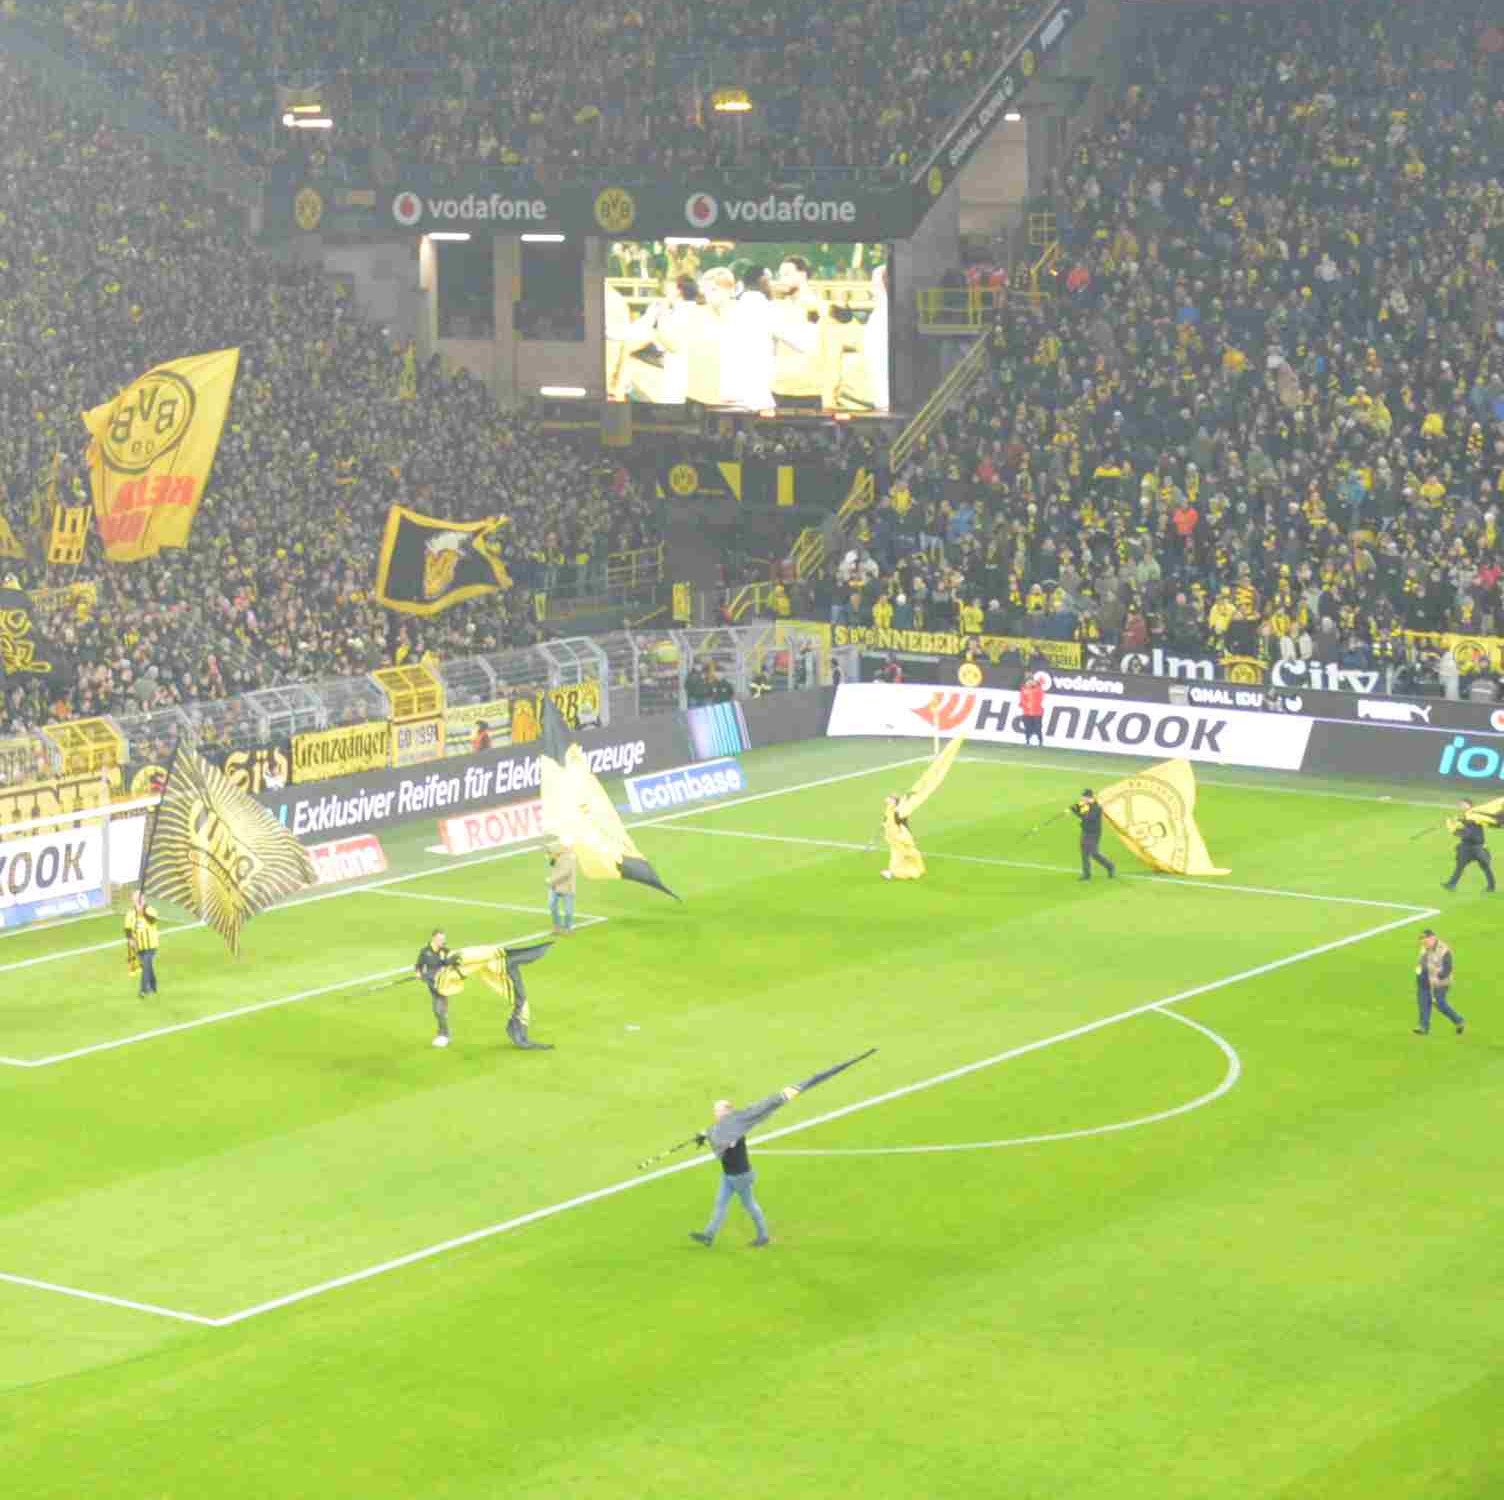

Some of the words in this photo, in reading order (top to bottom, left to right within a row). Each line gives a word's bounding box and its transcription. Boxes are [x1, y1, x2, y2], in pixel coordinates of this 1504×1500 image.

[428, 195, 547, 221] vodafone
[724, 193, 857, 224] vodafone
[1055, 676, 1124, 694] vodafone
[292, 782, 393, 837] Exklusiver
[398, 763, 460, 814] Reifen
[464, 762, 492, 800] für
[640, 767, 741, 810] coinbase
